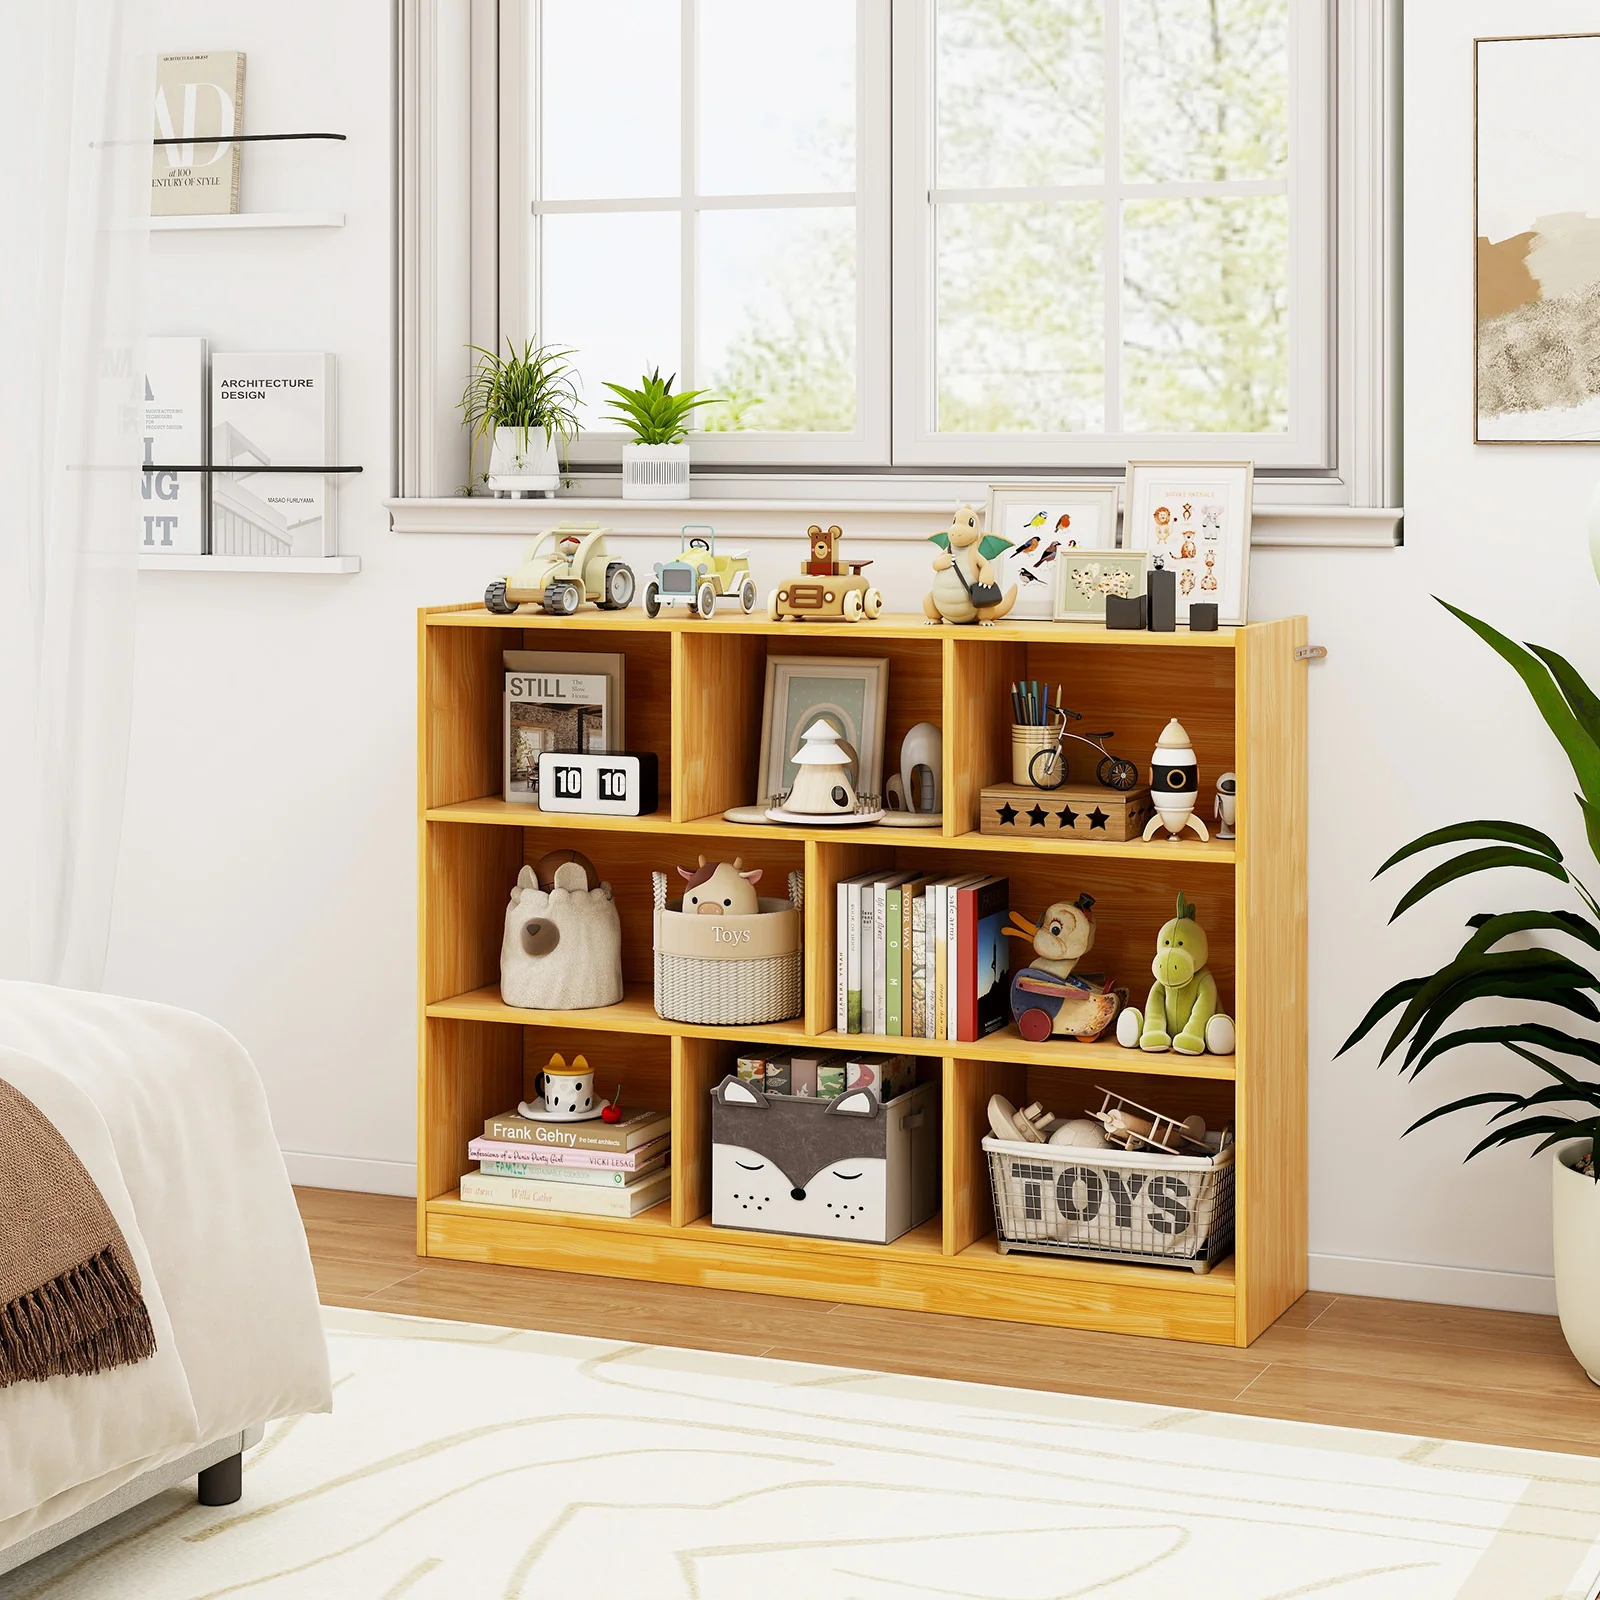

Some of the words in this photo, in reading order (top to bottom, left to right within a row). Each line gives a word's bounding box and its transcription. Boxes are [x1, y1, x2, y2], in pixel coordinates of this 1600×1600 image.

[151, 178, 184, 188] ENTURY
[184, 177, 196, 187] OF
[196, 176, 221, 186] STYLE
[220, 378, 314, 389] ARCHITECTURE
[220, 390, 267, 400] DESIGN
[509, 676, 567, 699] STILL
[556, 769, 582, 794] 10
[601, 772, 627, 797] 10
[949, 895, 957, 914] safe
[711, 926, 751, 947] Toys
[889, 904, 899, 1022] HOME
[492, 1122, 532, 1141] Frank
[535, 1126, 577, 1148] Gehry
[587, 1137, 597, 1145] best
[597, 1138, 621, 1147] architects
[589, 1156, 610, 1167] VICKI
[1011, 1162, 1192, 1235] TOYS
